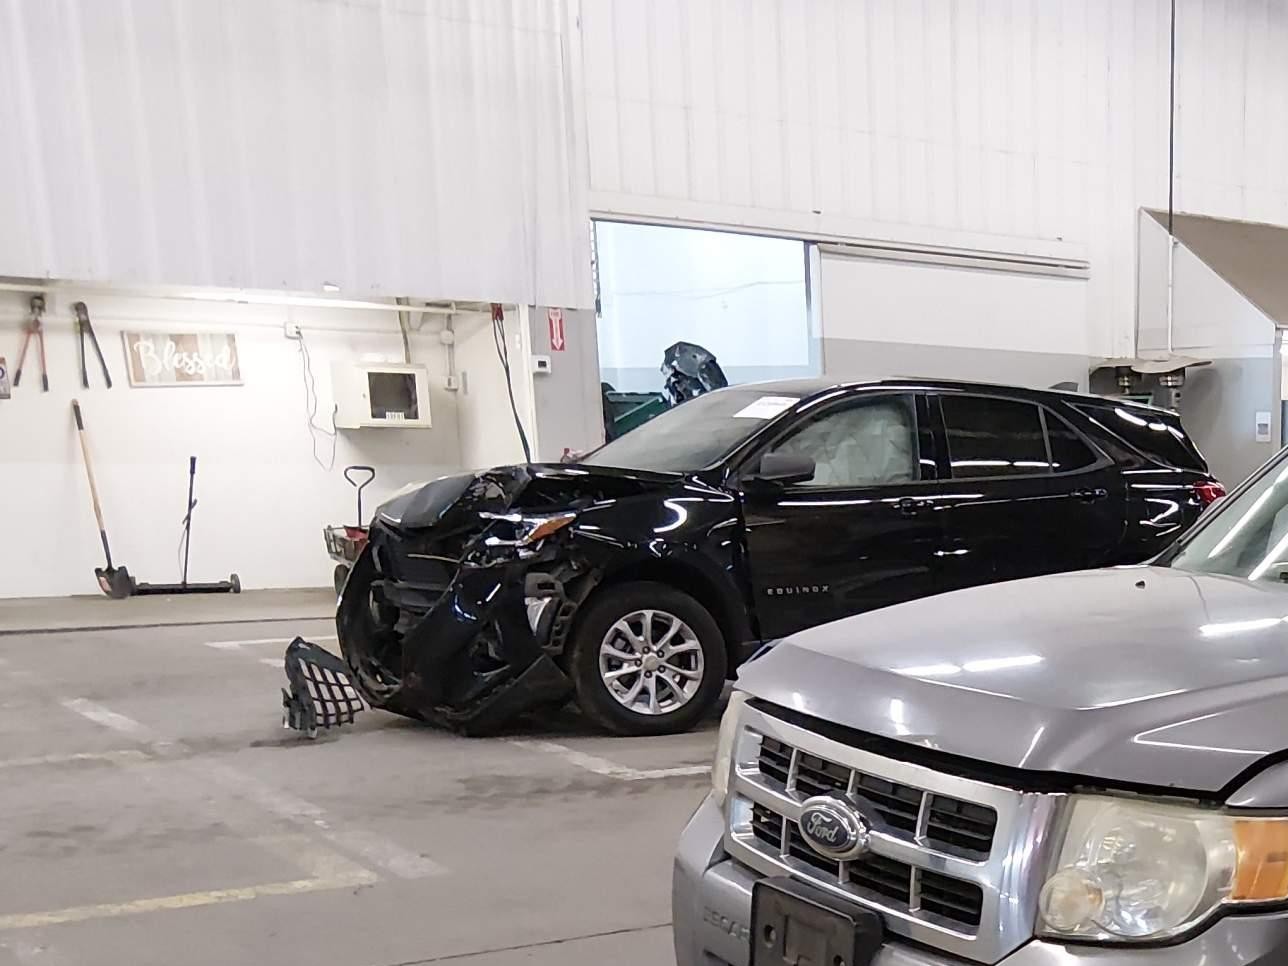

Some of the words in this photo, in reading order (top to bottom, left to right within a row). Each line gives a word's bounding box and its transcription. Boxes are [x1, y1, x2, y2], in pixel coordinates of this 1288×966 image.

[133, 340, 235, 375] Blessed
[767, 585, 829, 596] EQUINOX
[807, 812, 840, 843] Ford
